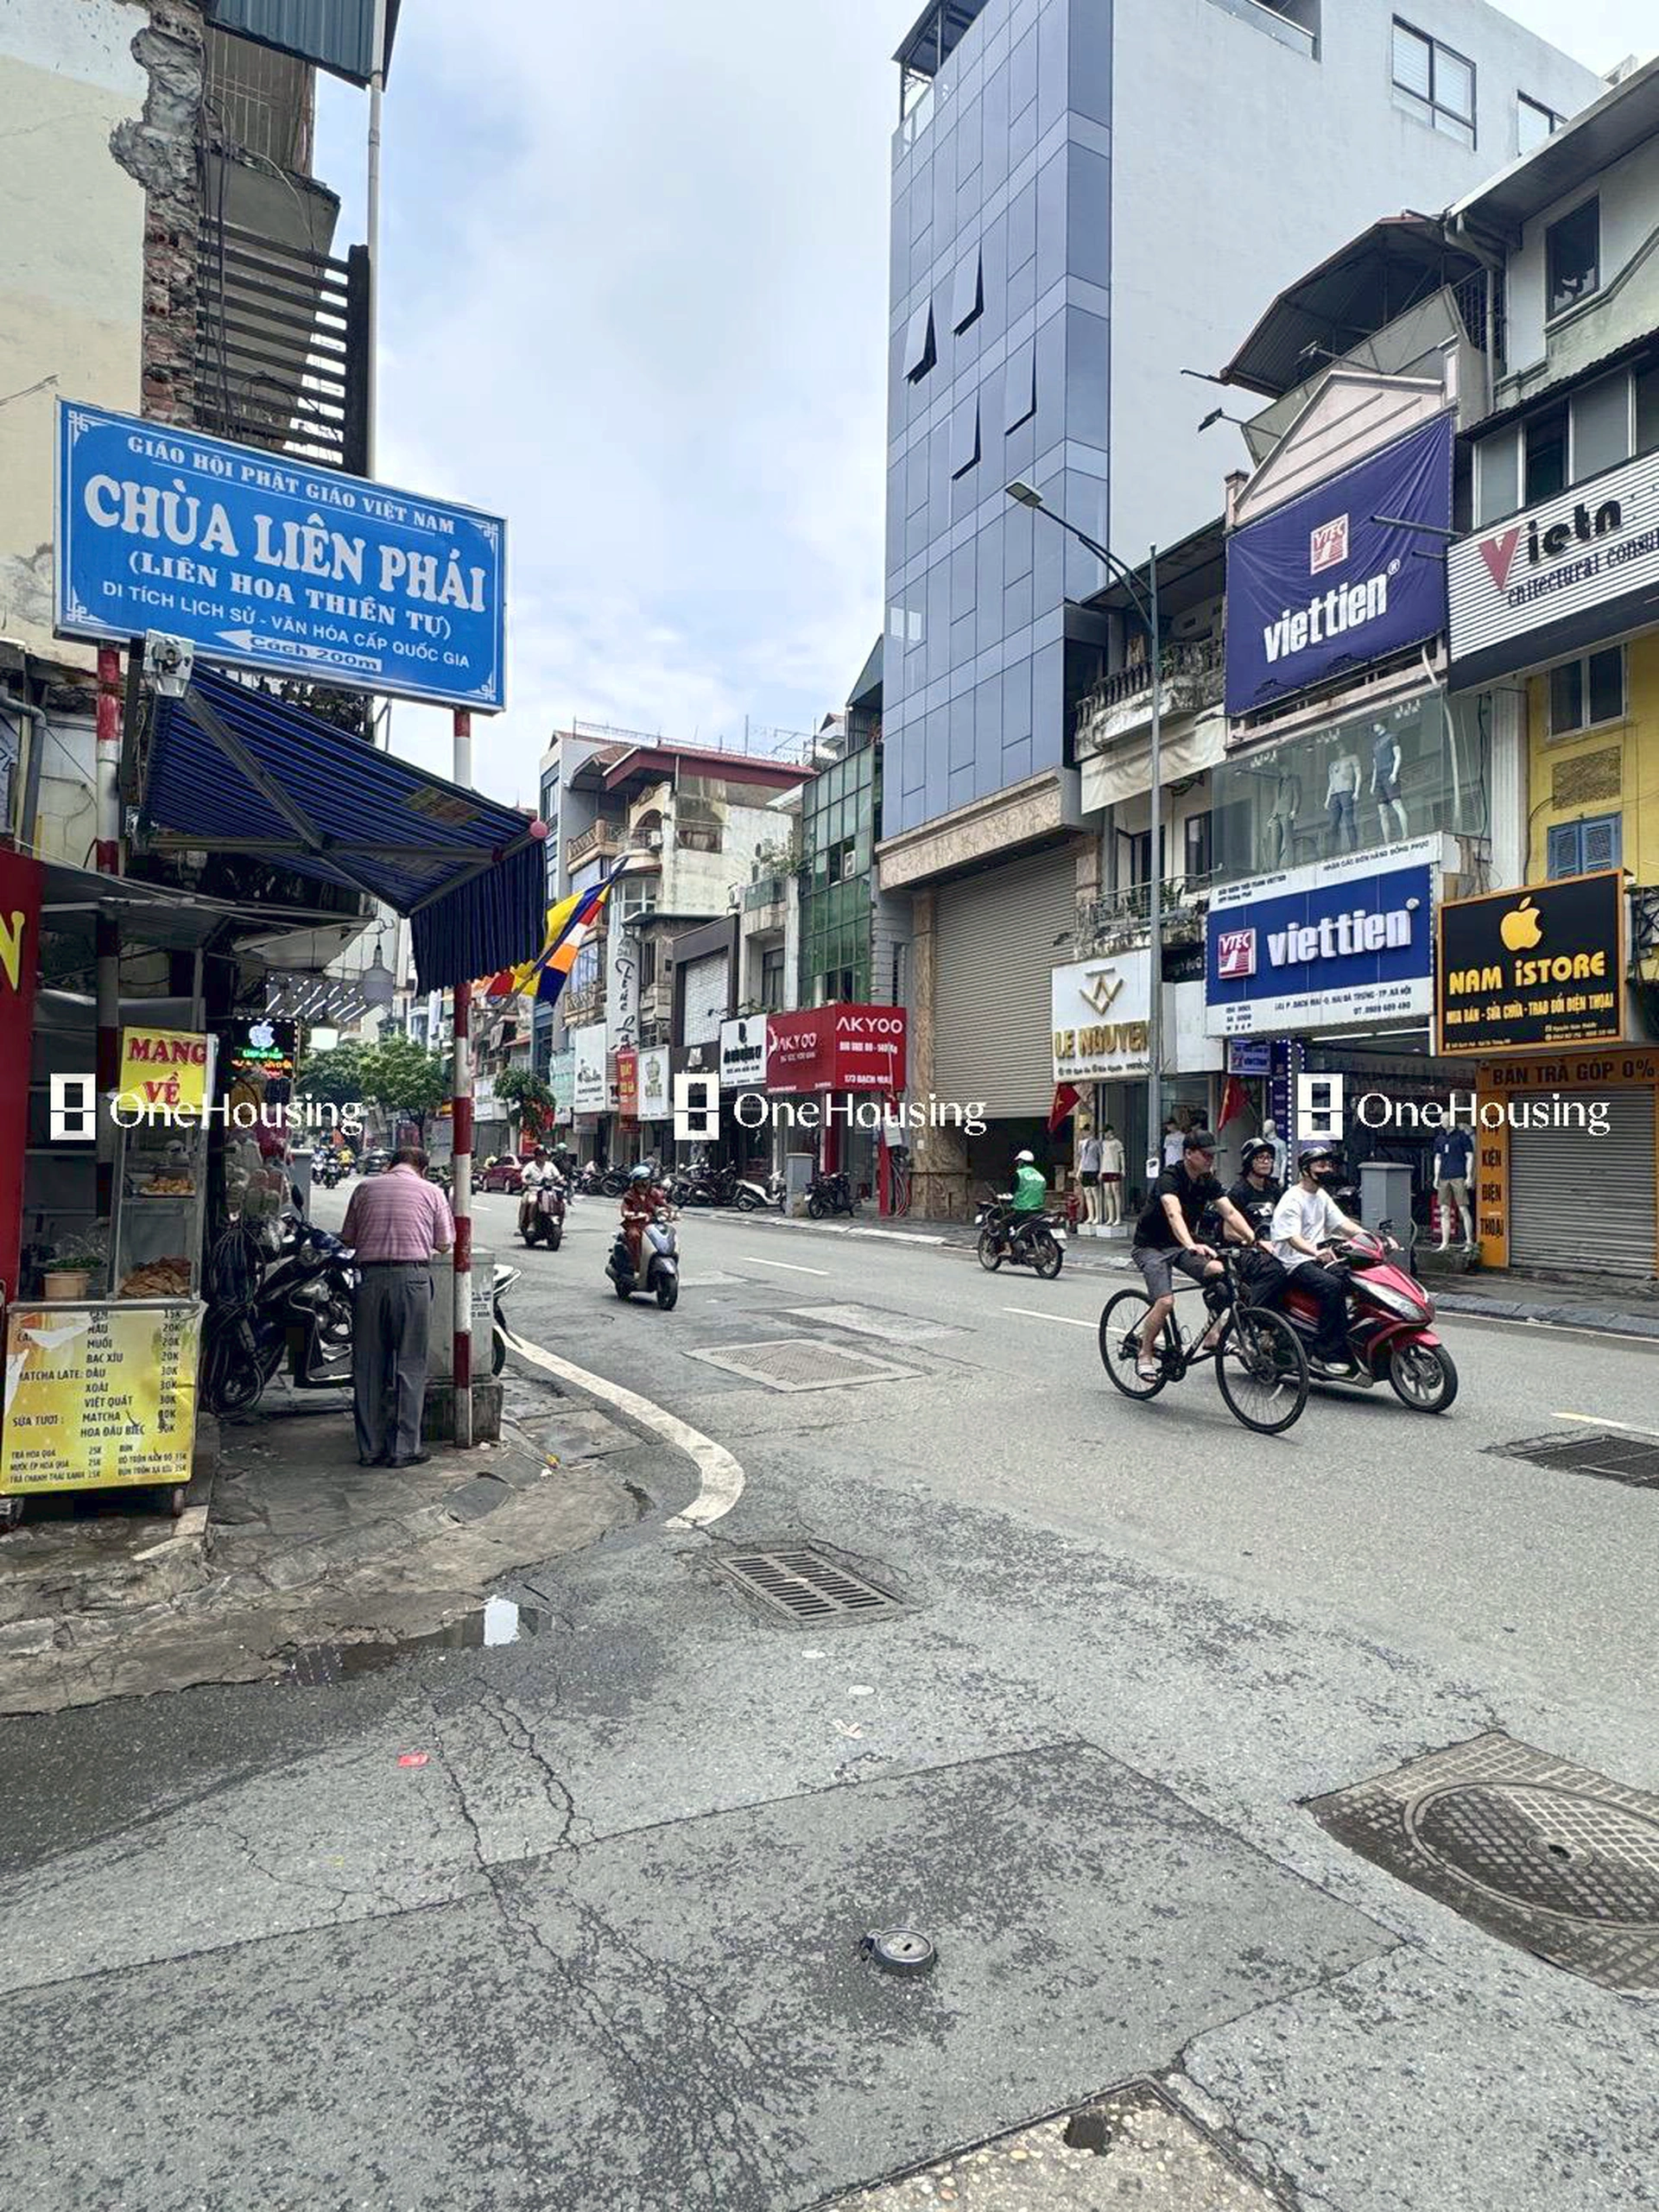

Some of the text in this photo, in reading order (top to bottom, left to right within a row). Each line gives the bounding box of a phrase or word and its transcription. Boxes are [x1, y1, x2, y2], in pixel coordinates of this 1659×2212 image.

[128, 434, 455, 535] GIÁO HỘI PHẬT GIÁO VIỆT NAM
[85, 473, 486, 613] CHÙA LIÊN PHÁI
[129, 550, 218, 588] (LIÊN
[230, 572, 295, 605] HOA
[103, 580, 123, 598] DI
[130, 581, 174, 610] TÍCH
[180, 599, 225, 620] LỊCH
[229, 605, 257, 627] SỬ
[271, 614, 307, 637] VĂN
[313, 621, 349, 644] HÓA
[354, 628, 388, 651] CẤP
[393, 637, 439, 662] QUỐC
[443, 649, 471, 669] GIA
[1263, 571, 1389, 663] viettien
[250, 635, 379, 671] Cách 200m
[1220, 932, 1251, 954] VTEC
[1267, 909, 1412, 967] viettien
[1449, 951, 1605, 995] NAM iSTORE
[836, 1017, 902, 1034] AKYOO
[127, 1037, 207, 1063] MANG
[1493, 1062, 1529, 1086] BÁN
[1576, 1059, 1614, 1081] GÓP
[1622, 1057, 1656, 1079] 0%
[142, 1072, 180, 1106] VỀ
[1481, 1146, 1502, 1172] KIỆN
[1481, 1181, 1502, 1205] ĐIỆN
[1479, 1217, 1504, 1239] THOẠI
[83, 1411, 120, 1423] MATCHA
[80, 1428, 100, 1438] HOA
